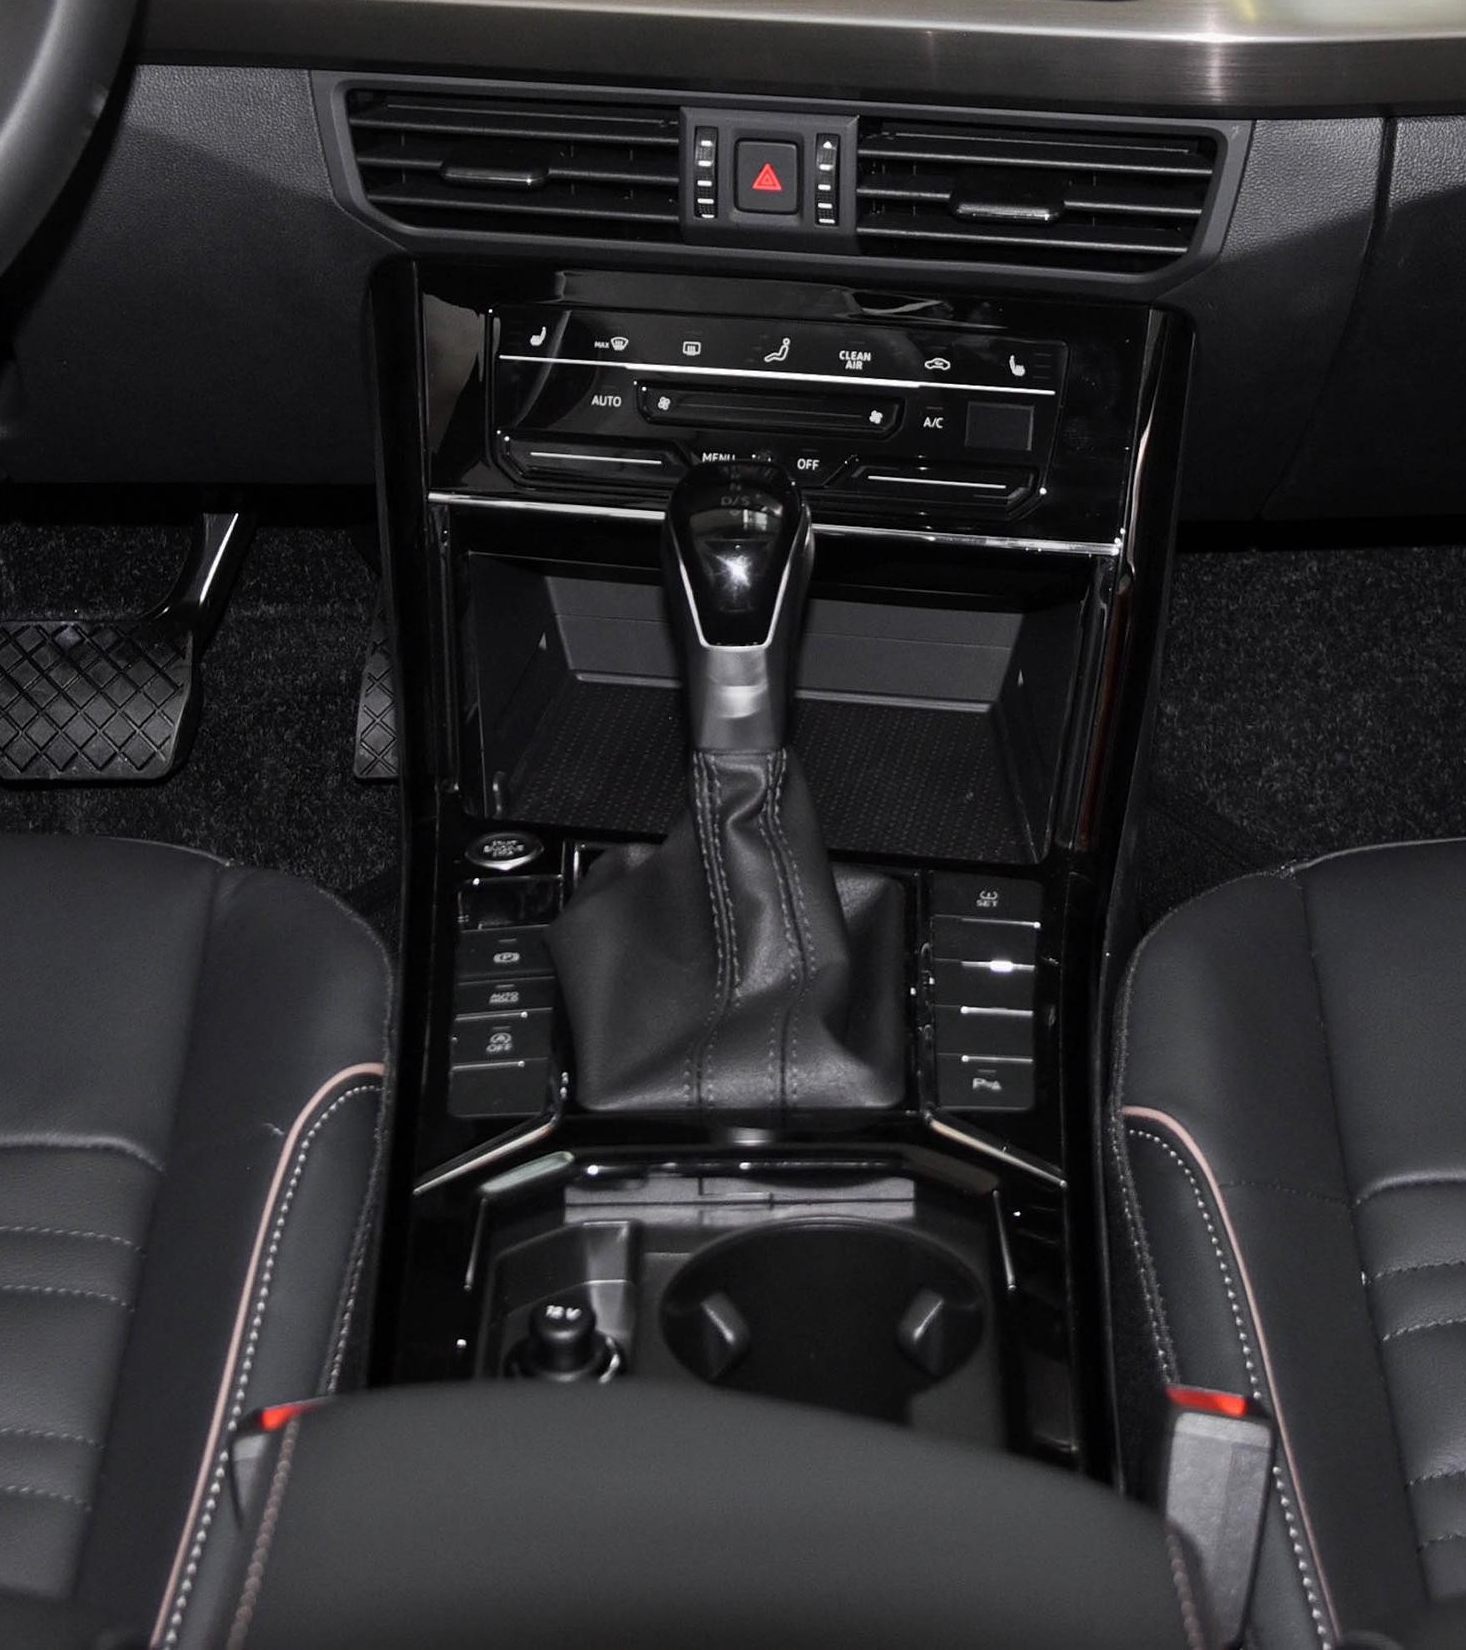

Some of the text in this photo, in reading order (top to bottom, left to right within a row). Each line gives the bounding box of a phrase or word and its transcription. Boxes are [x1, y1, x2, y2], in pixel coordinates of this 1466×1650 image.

[594, 340, 610, 349] MAX
[837, 349, 873, 362] CLEAN
[843, 359, 864, 371] AIR
[591, 394, 623, 408] AUTO
[922, 416, 944, 429] A/C
[796, 458, 820, 471] OFF
[975, 898, 999, 908] SET
[486, 1043, 512, 1053] OFF
